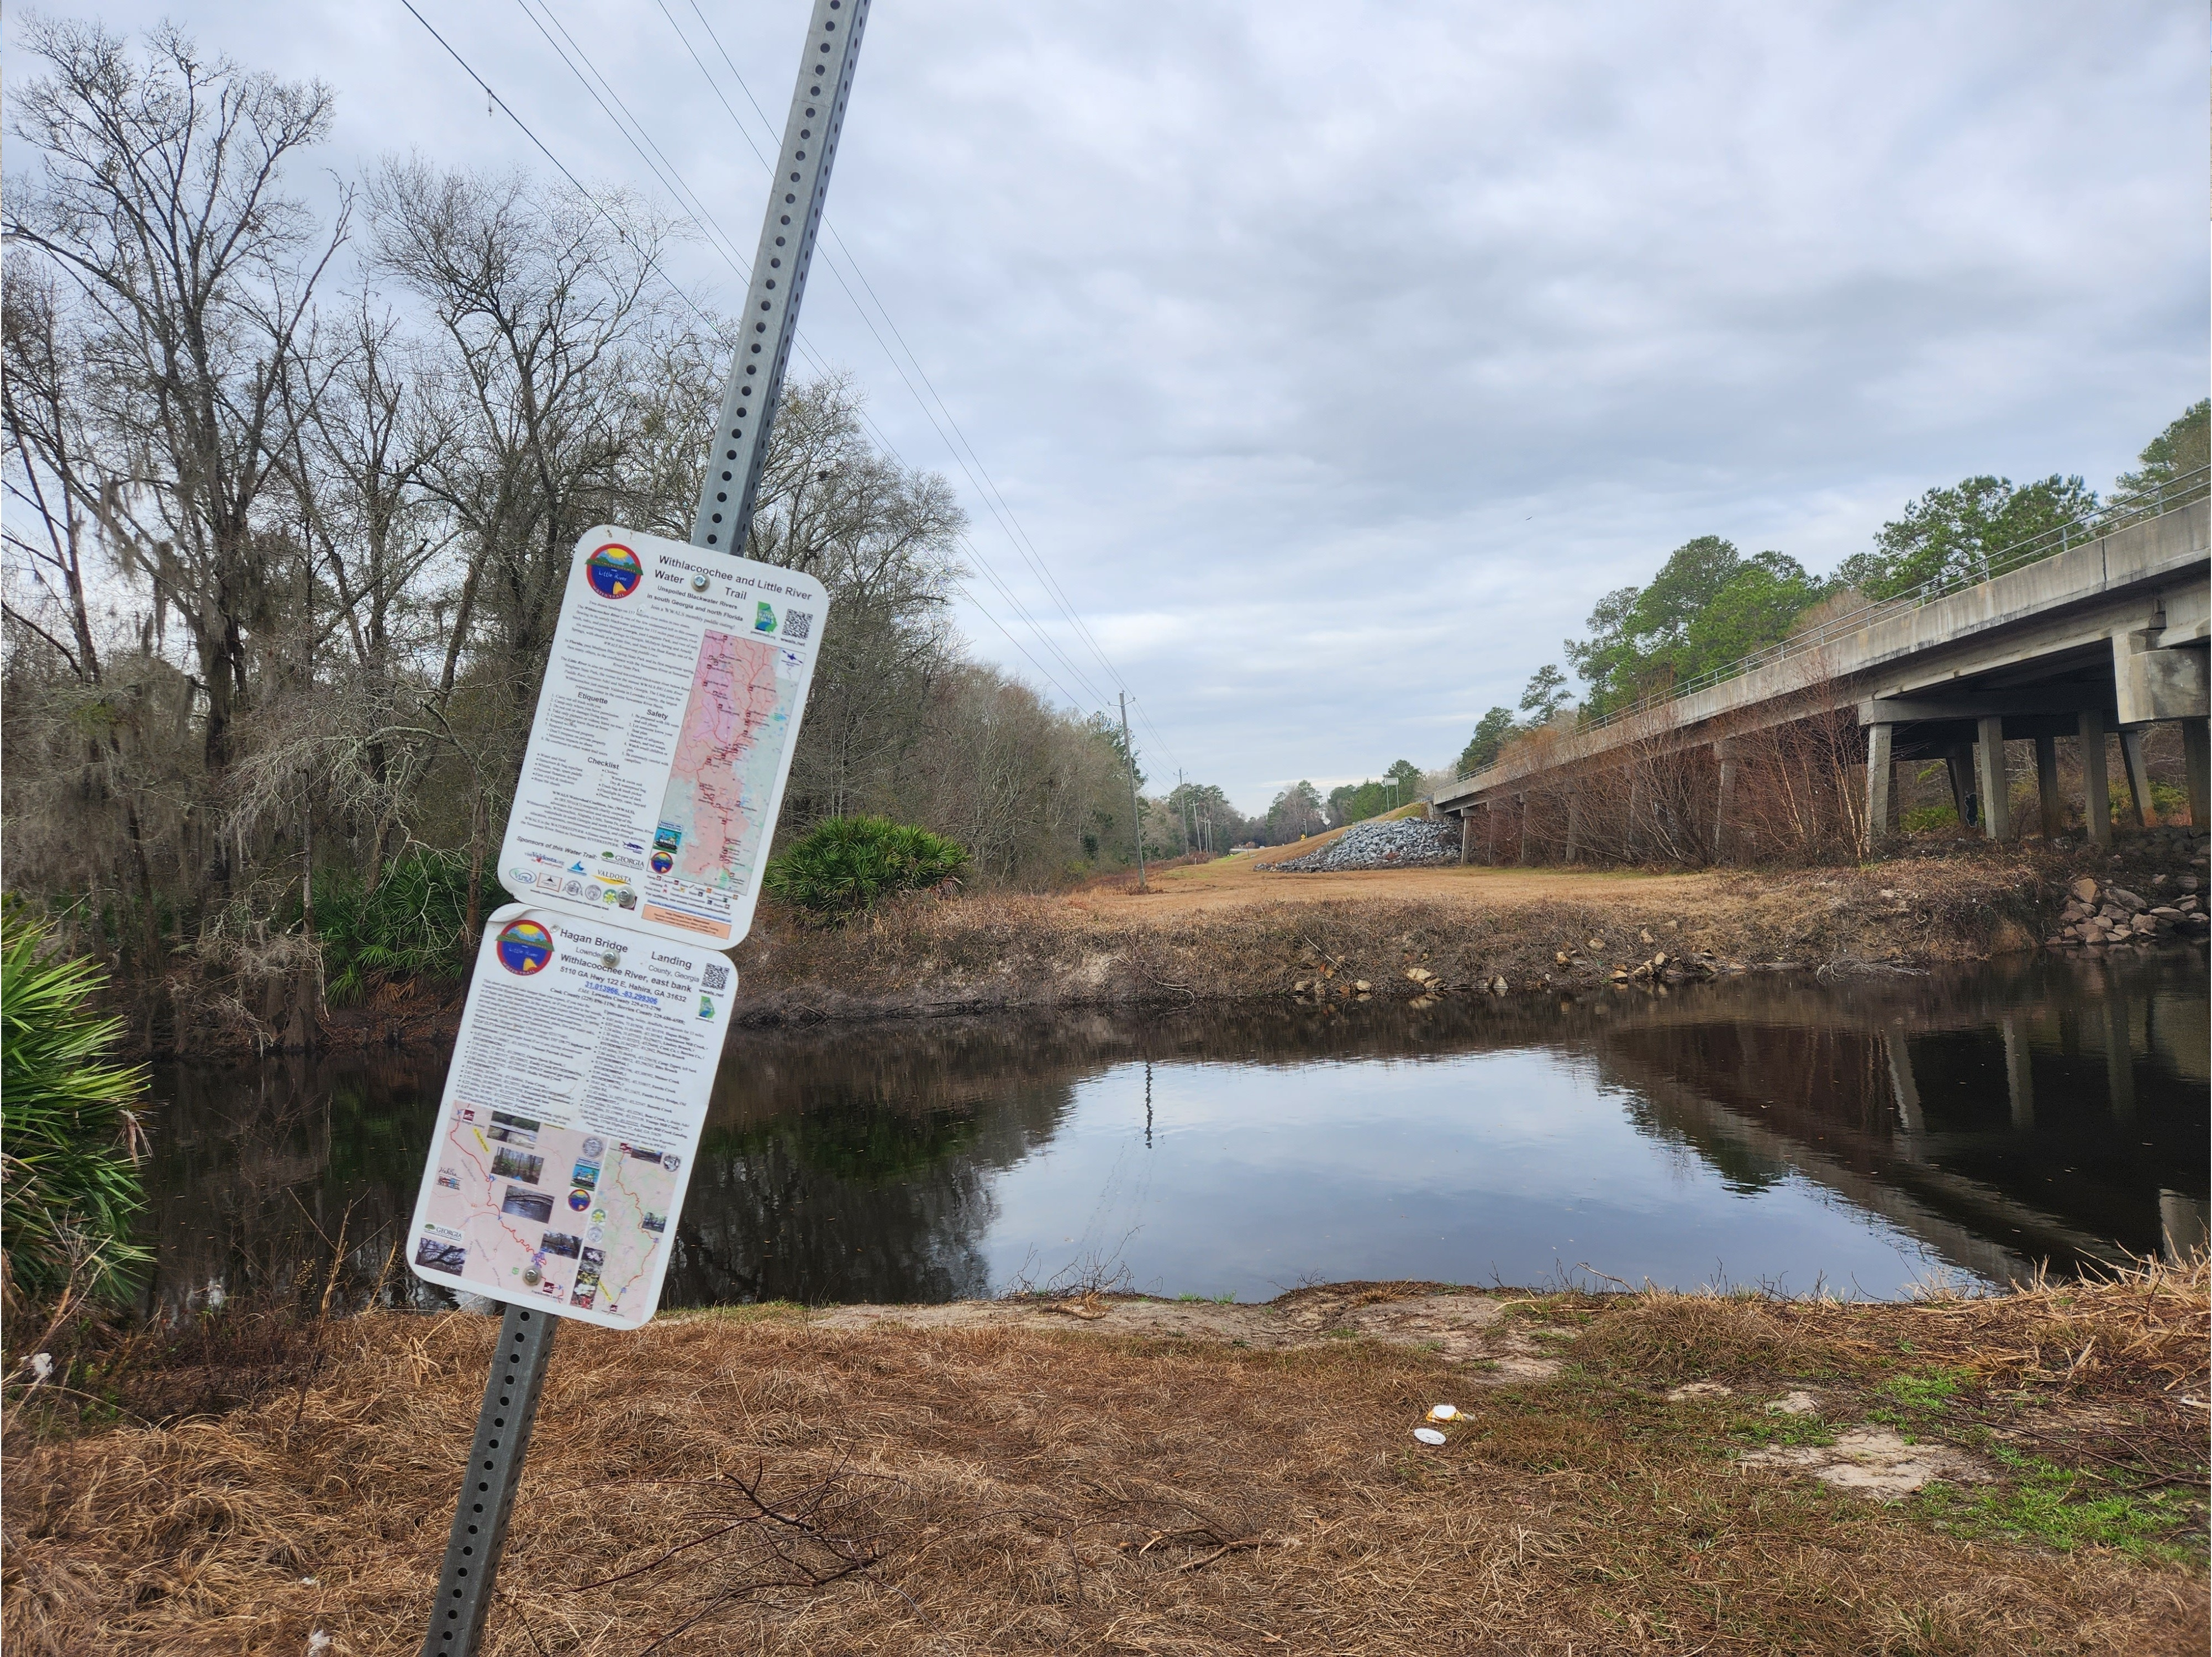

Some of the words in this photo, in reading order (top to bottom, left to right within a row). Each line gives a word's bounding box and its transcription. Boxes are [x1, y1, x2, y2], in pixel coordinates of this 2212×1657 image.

[654, 570, 684, 584] Water
[724, 587, 746, 600] Trail
[658, 555, 734, 581] Withlacoochee
[734, 574, 756, 587] and
[756, 580, 784, 594] Little
[784, 587, 812, 600] River
[592, 585, 609, 598] WATER
[657, 585, 686, 598] Unspoiled
[686, 592, 719, 605] Blackwater
[719, 600, 738, 609] Rivers
[653, 595, 671, 603] south
[670, 599, 694, 610] Georgia
[706, 608, 723, 616] north
[723, 611, 743, 621] Florida
[577, 692, 608, 705] Etiquette
[646, 709, 668, 721] Safety
[587, 757, 619, 769] Checklist
[517, 836, 544, 847] Sponsors
[564, 847, 582, 856] Water
[614, 854, 645, 867] GEORGIA
[597, 869, 631, 883] VALDOSTA
[559, 928, 593, 946] Hagan
[593, 937, 628, 954] Bridge
[650, 951, 692, 970] Landing
[502, 962, 518, 973] WATER
[560, 954, 623, 975] Withlacoochee
[623, 969, 650, 983] River,
[650, 976, 670, 987] east
[670, 980, 692, 993] bank
[575, 947, 602, 958] Lownde
[647, 965, 673, 978] County,
[673, 972, 699, 984] Georgia
[560, 966, 577, 975] 5110
[577, 970, 589, 978] GA
[589, 973, 606, 984] Hwy
[606, 977, 619, 985] 122
[628, 983, 653, 995] Hahira,
[653, 989, 666, 997] GA
[666, 992, 687, 1002] 31632
[584, 981, 620, 996] 31.013966,
[622, 990, 658, 1004] -83.299306
[436, 1227, 462, 1238] GEORGIA
